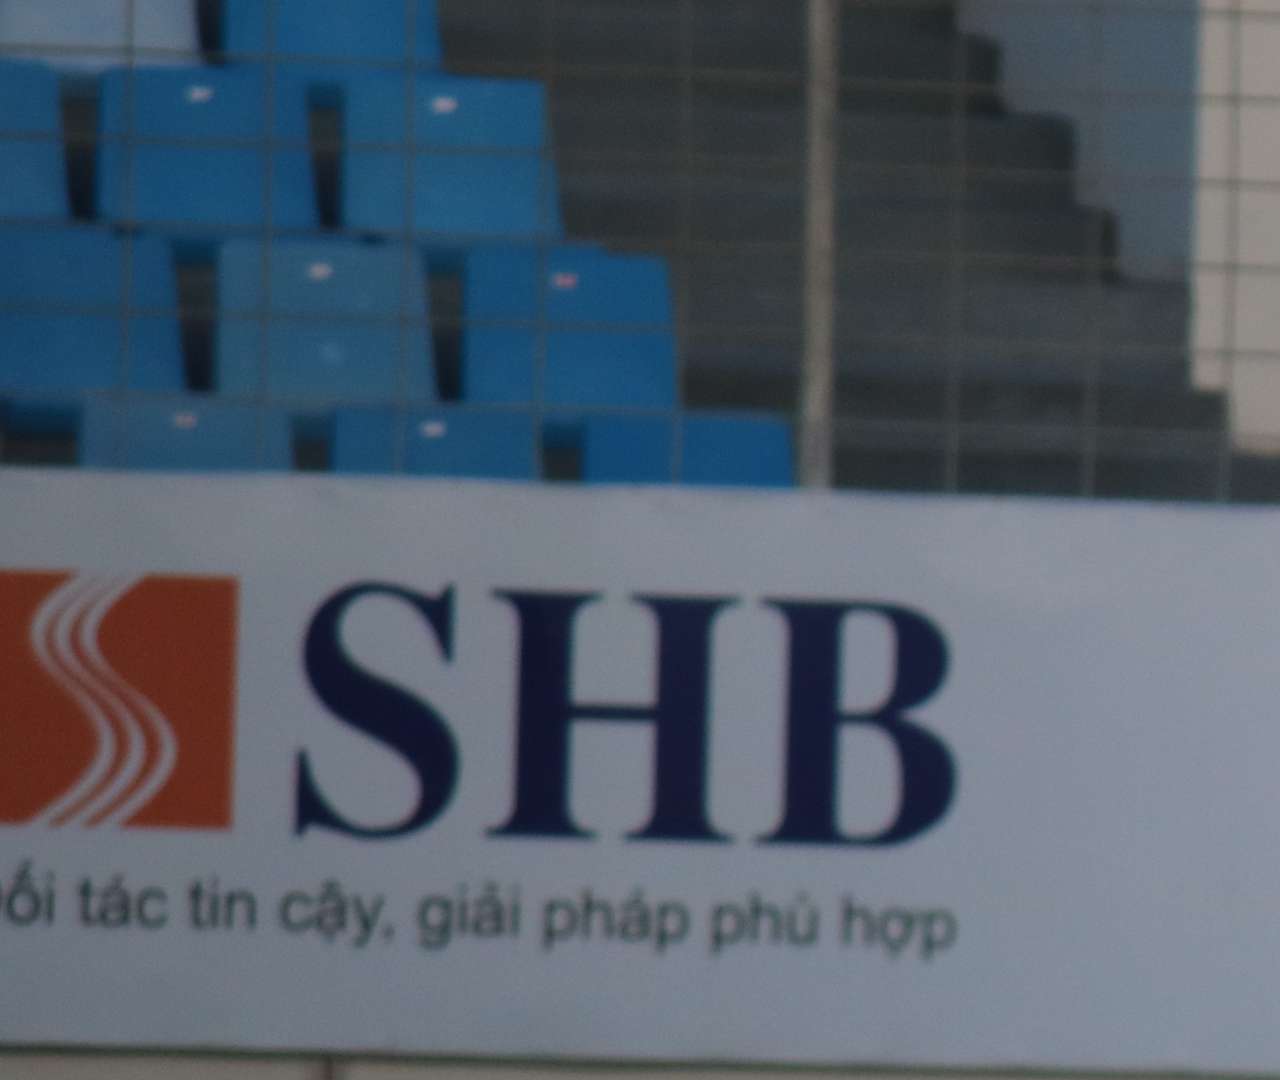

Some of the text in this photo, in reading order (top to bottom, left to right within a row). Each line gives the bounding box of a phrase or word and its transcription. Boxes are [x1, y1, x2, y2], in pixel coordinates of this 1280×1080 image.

[294, 580, 958, 847] SHB
[0, 858, 56, 928] ối
[76, 872, 169, 929] tác
[188, 874, 258, 930] tin
[540, 885, 692, 957] pháp
[837, 891, 960, 962] hợp
